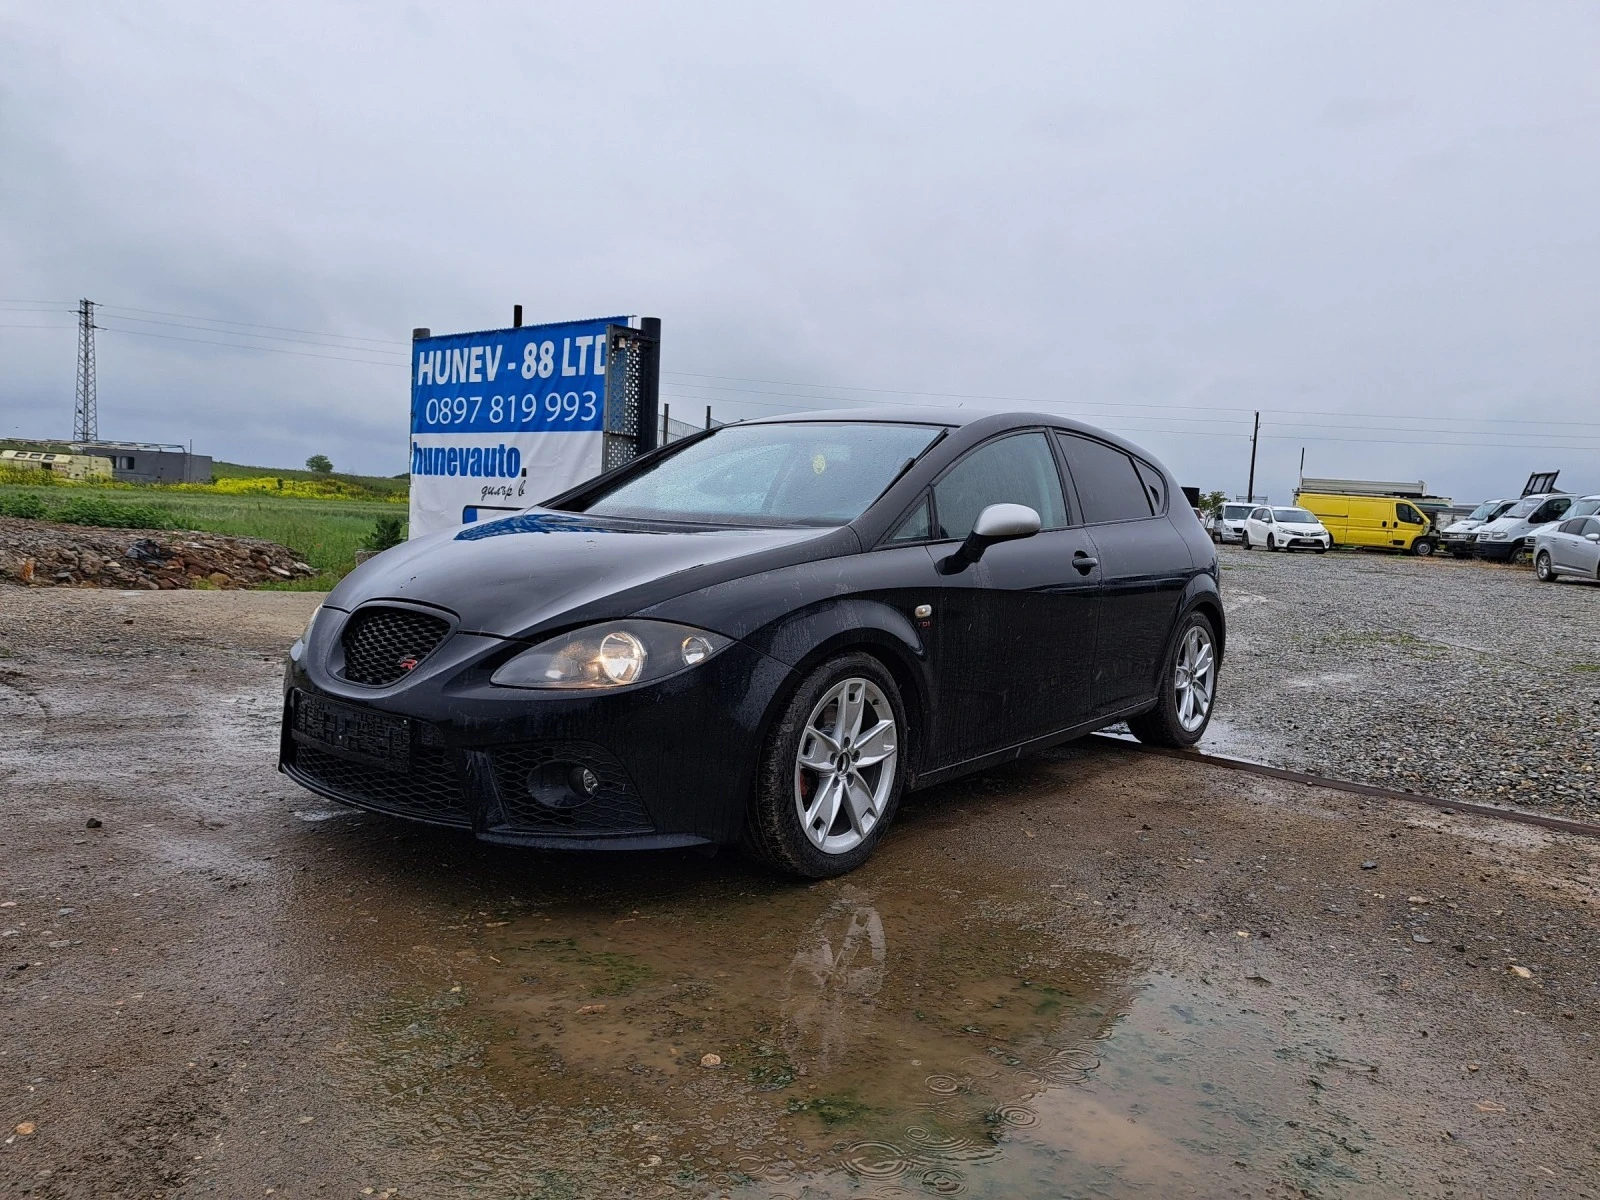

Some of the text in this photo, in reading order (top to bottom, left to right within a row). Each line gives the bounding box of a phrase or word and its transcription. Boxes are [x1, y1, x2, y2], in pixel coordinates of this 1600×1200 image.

[418, 345, 503, 385] HUNEV
[521, 341, 555, 379] 88
[425, 391, 597, 424] 0897 819 993
